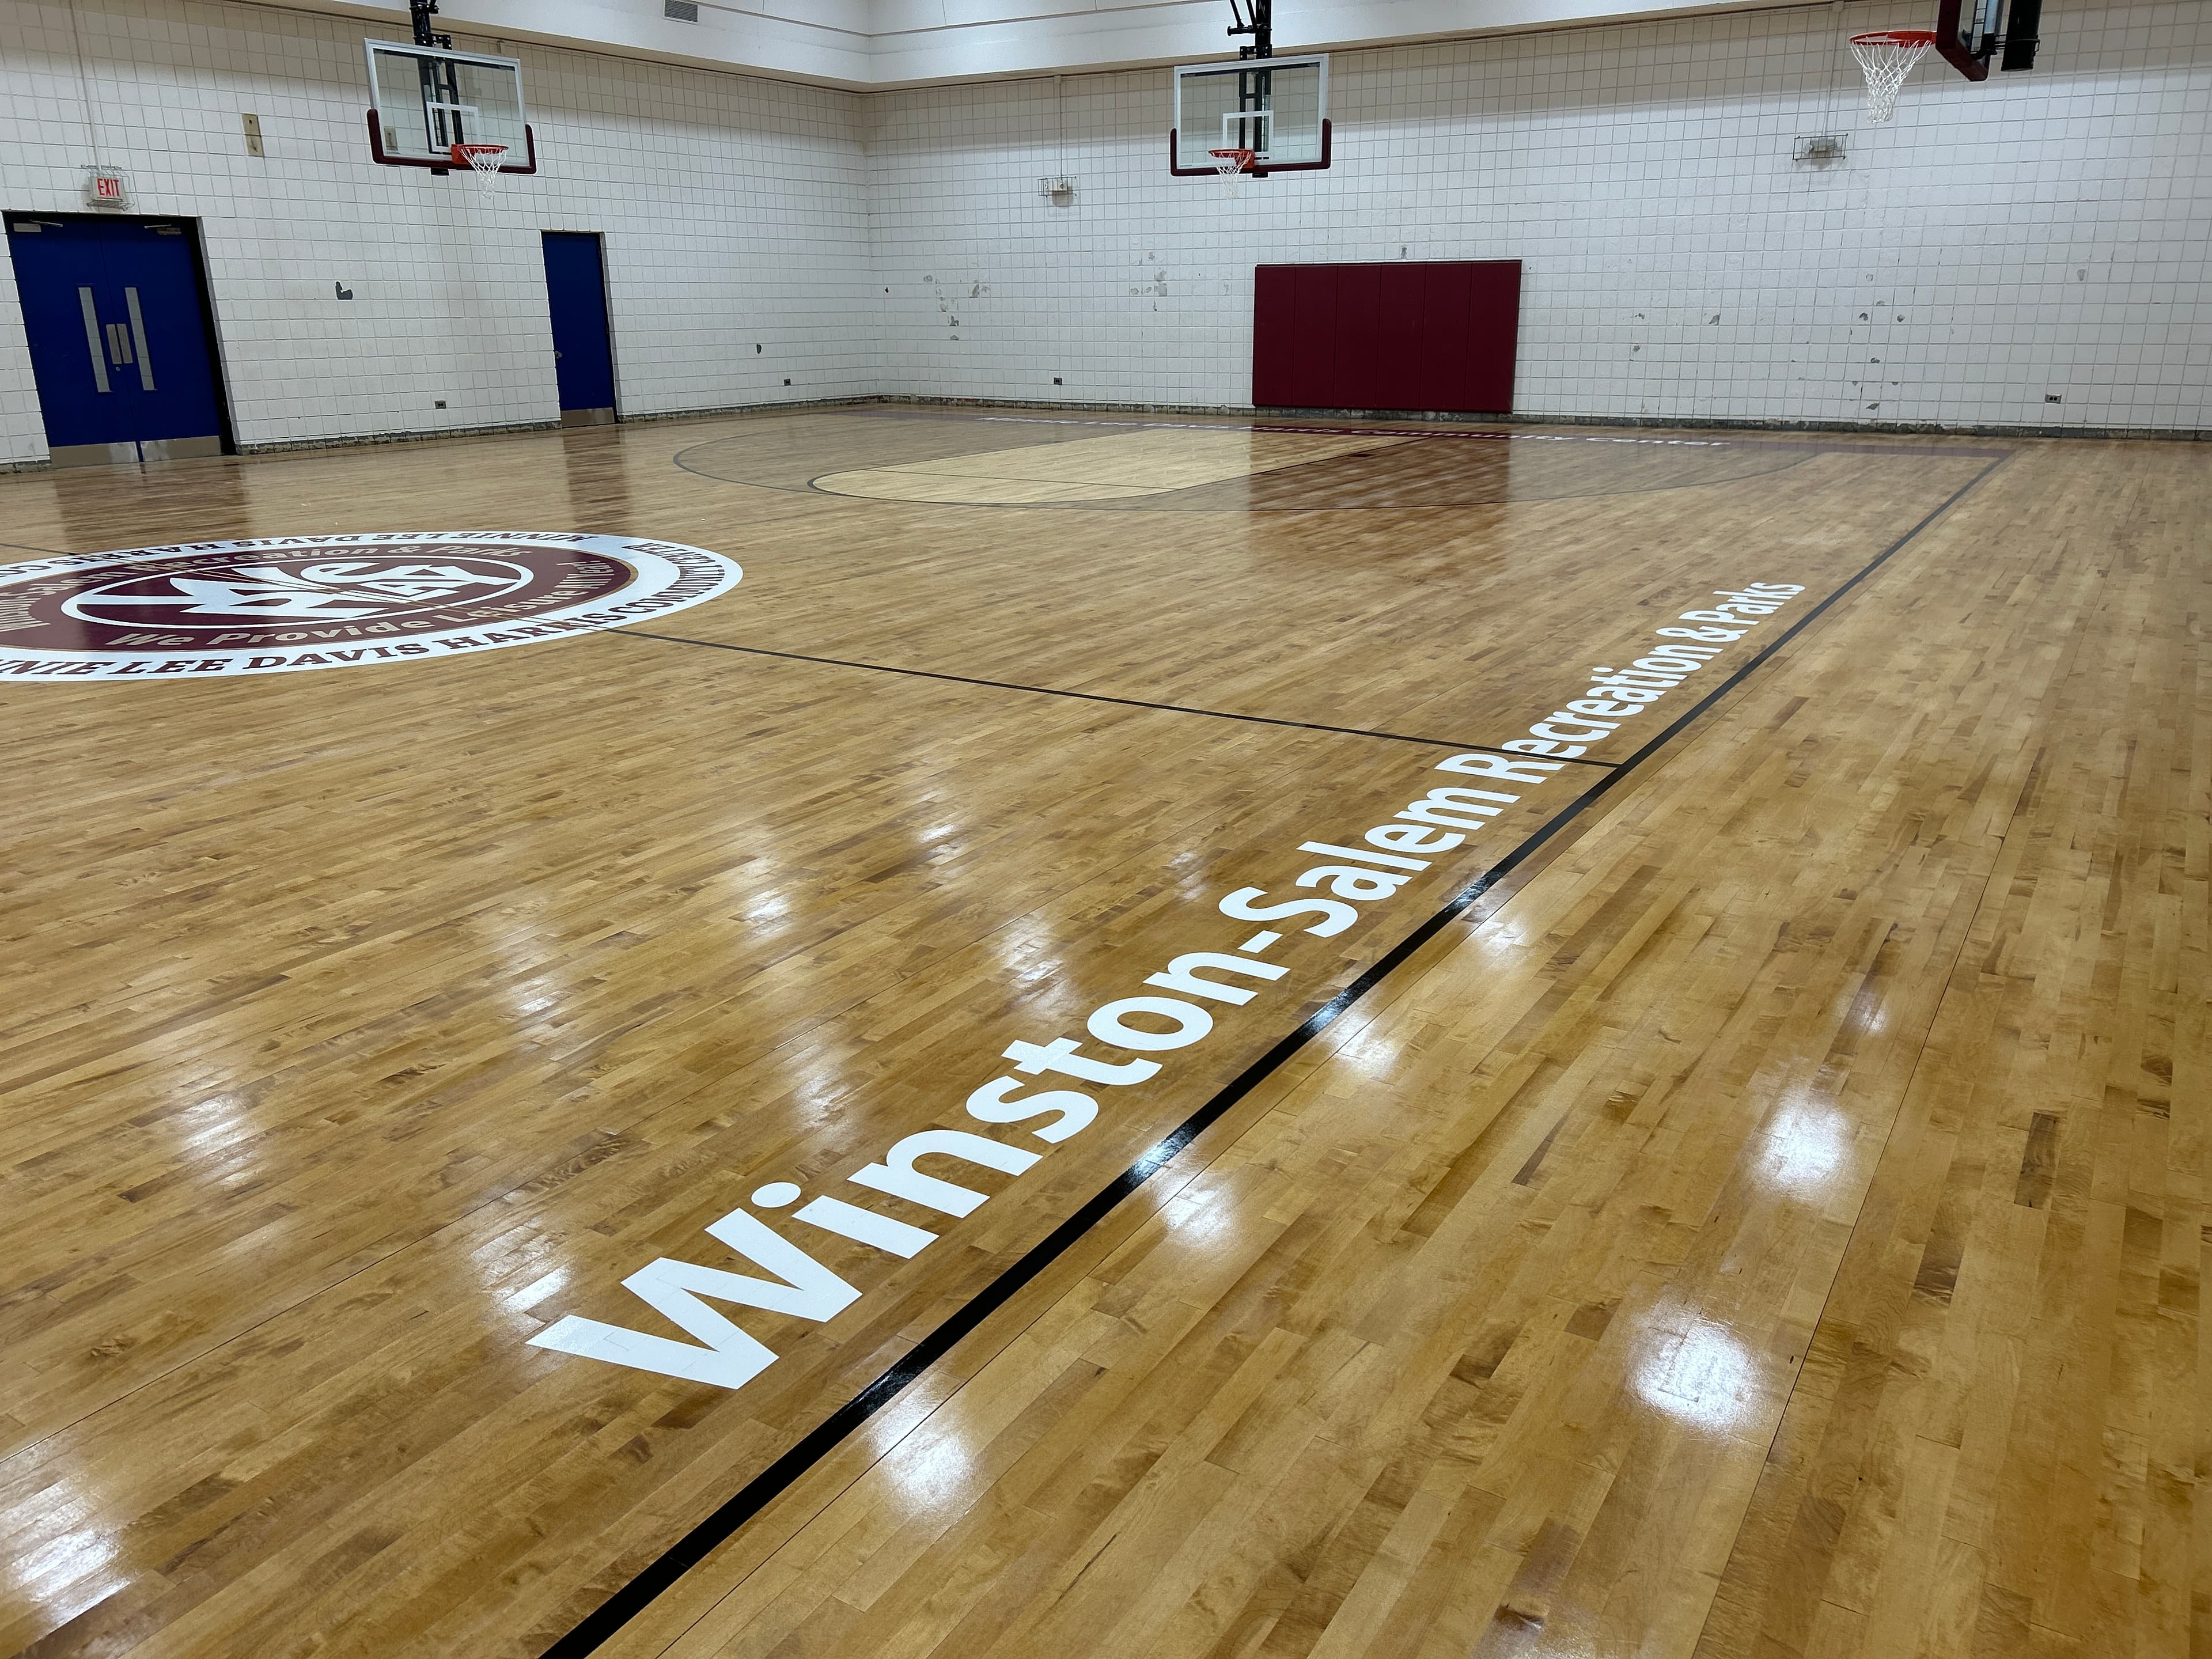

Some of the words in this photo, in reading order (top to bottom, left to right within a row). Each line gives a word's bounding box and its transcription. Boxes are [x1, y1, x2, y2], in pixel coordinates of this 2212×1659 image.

[97, 178, 120, 196] EXIT
[1351, 430, 1577, 441] Community
[1586, 437, 1730, 446] Center
[232, 535, 363, 547] DAVIS
[450, 533, 599, 542] MINNIE
[123, 548, 378, 571] Recreation
[425, 546, 532, 556] Parks
[622, 543, 716, 565] CENTER
[608, 565, 725, 613] COMMUNITY
[104, 633, 195, 645] We
[206, 620, 435, 645] Provide
[432, 590, 589, 622] Leisure
[554, 578, 612, 589] All
[1679, 582, 1805, 625] Parks
[433, 613, 627, 649] HARRIS
[1656, 627, 1749, 642] &
[106, 658, 233, 674] LEE
[243, 643, 430, 669] DAVIS
[1434, 644, 1724, 783] Recreation
[527, 787, 1521, 1389] Winston-Salem
